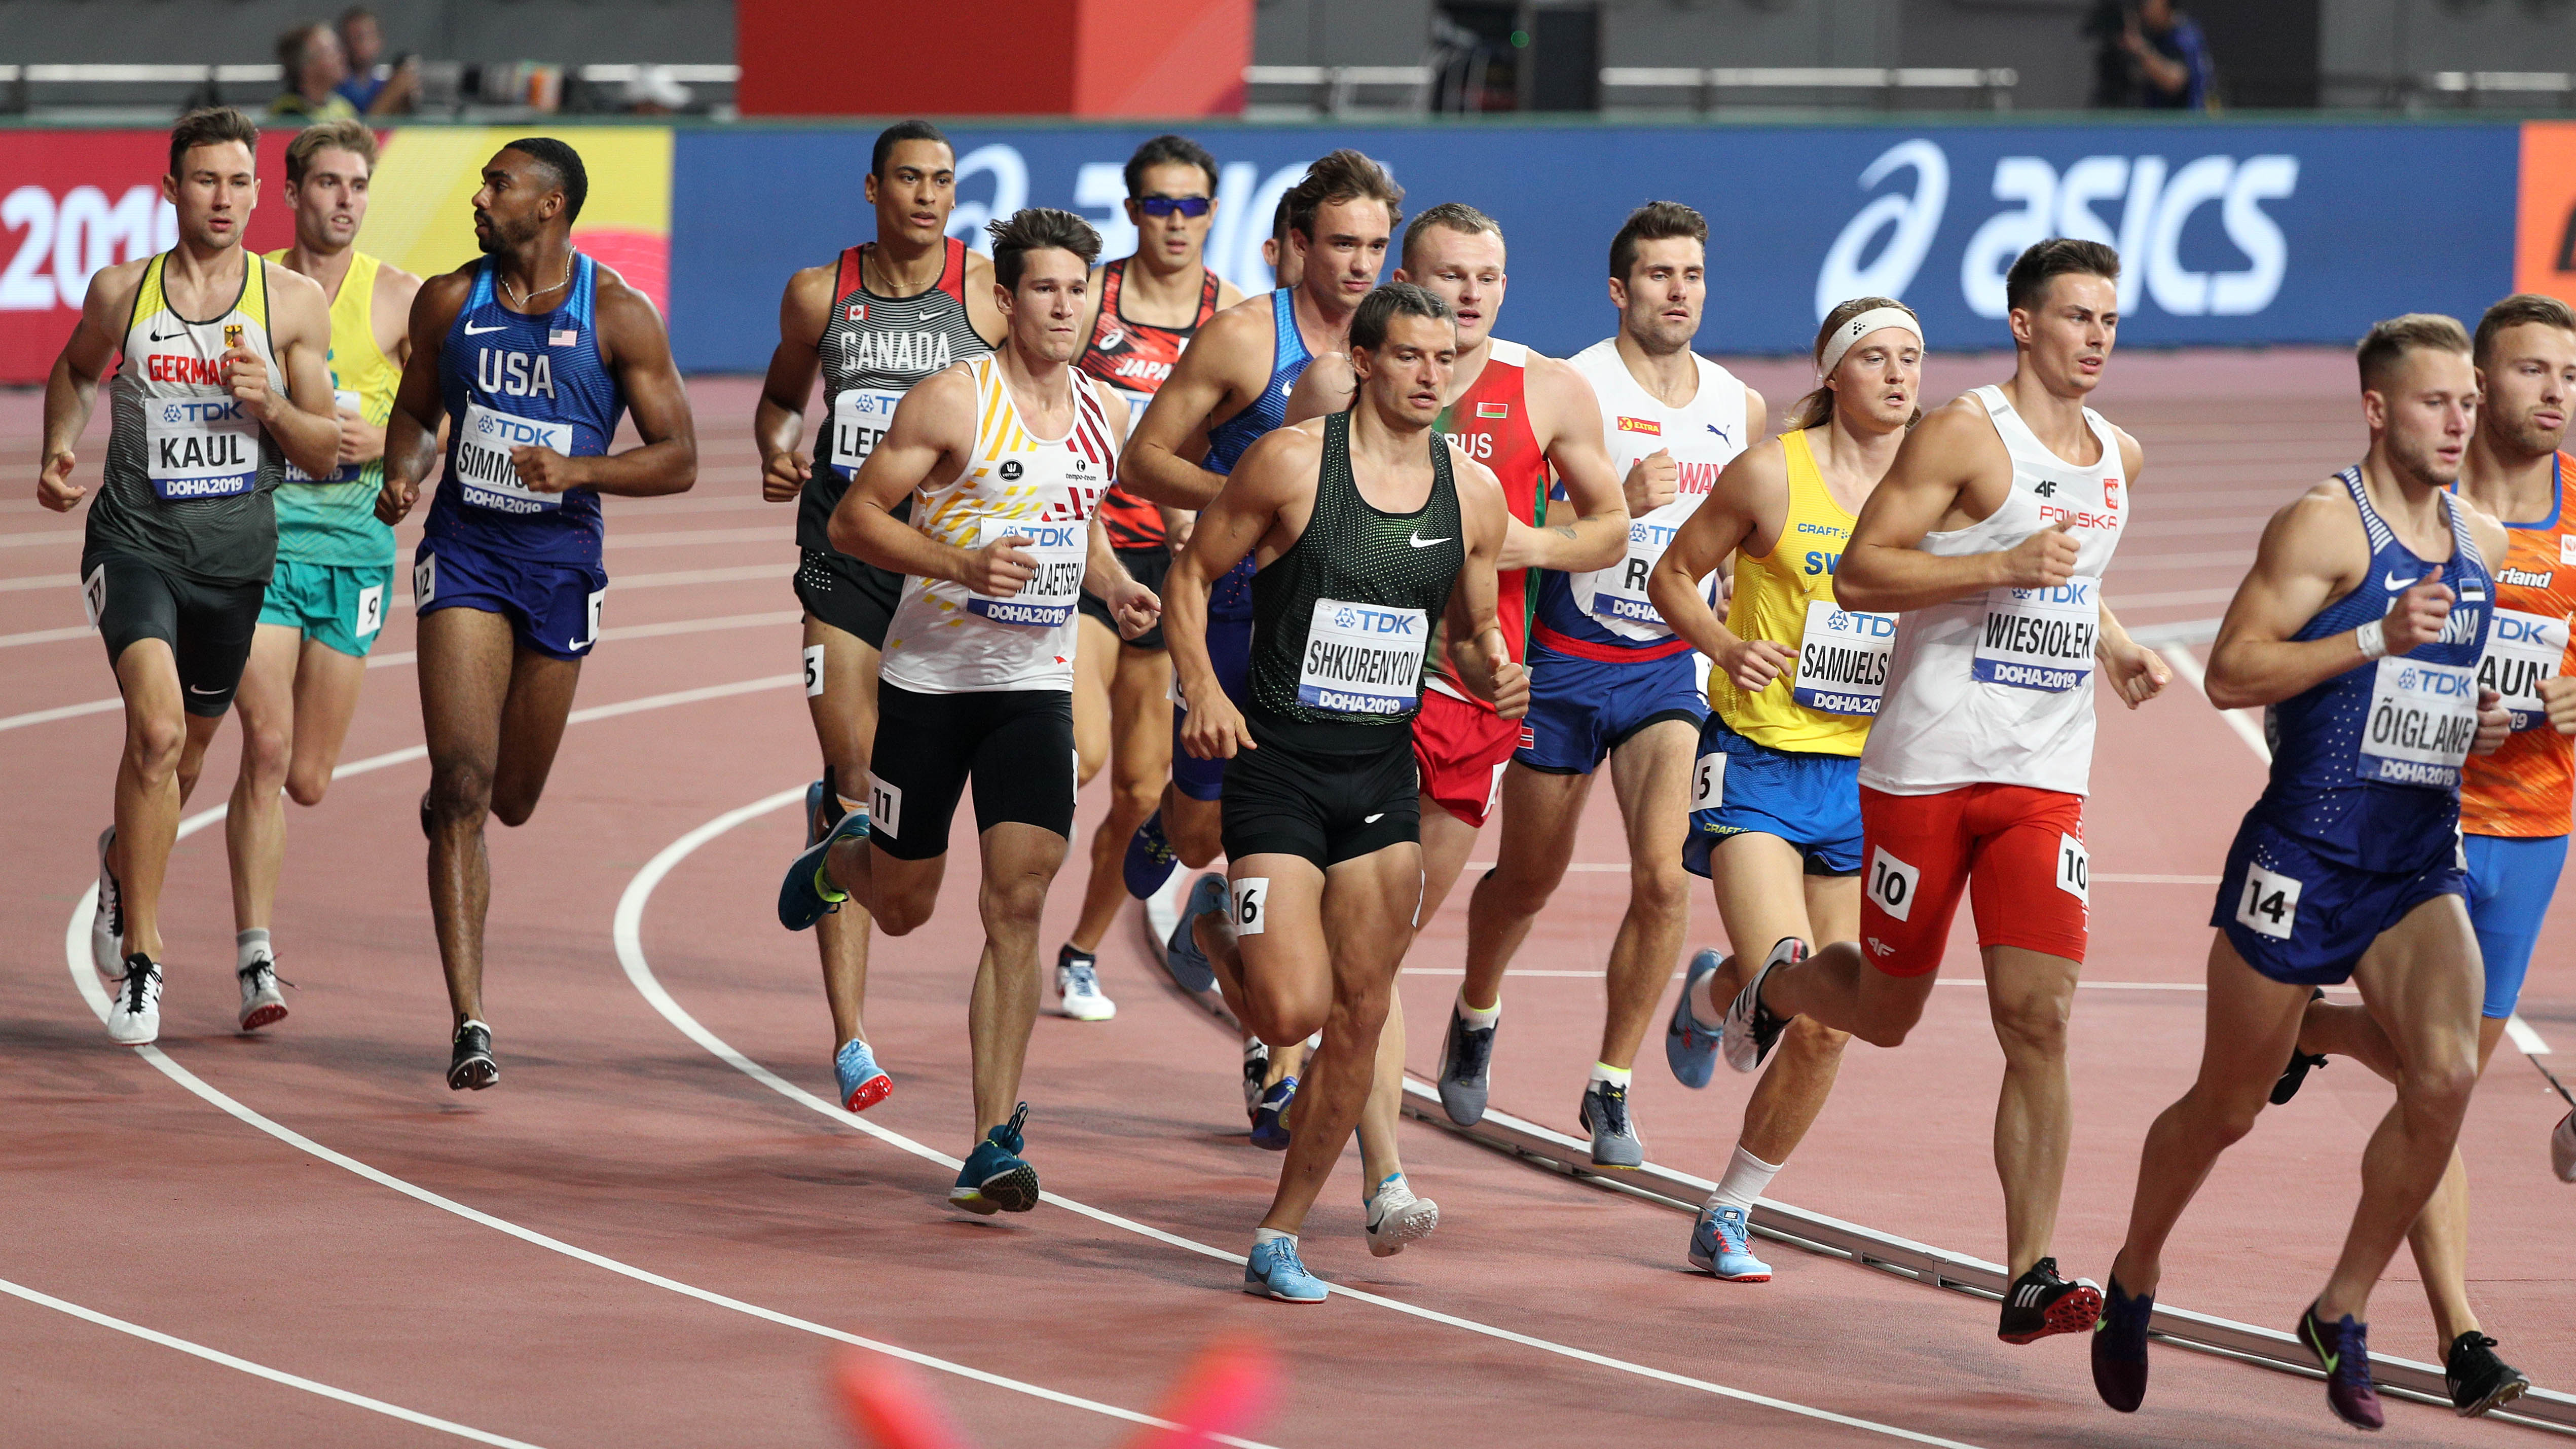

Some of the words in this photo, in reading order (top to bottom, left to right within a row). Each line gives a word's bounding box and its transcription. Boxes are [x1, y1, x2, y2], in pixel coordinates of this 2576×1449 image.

[840, 331, 951, 370] CANADA
[148, 354, 240, 386] GERMA
[478, 348, 555, 399] USA
[1115, 358, 1173, 381] JAPA
[181, 401, 243, 421] TDK
[495, 418, 556, 448] TDK
[1634, 421, 1660, 432] EXTRA
[160, 434, 245, 468] KAUL
[166, 476, 243, 496] DOHA2019
[2034, 480, 2057, 498] 4F
[1021, 527, 1075, 547] TDK
[1797, 523, 1839, 537] CRAFT
[2495, 567, 2553, 589] rland
[369, 597, 377, 624] 9
[986, 604, 1066, 624] DOHA2019
[1356, 609, 1416, 635] TDK
[1985, 612, 2094, 659] WIESIOŁEK
[1307, 640, 1420, 686] SHKURENYOV
[1802, 643, 1892, 686] SAMUELS
[1994, 663, 2077, 689] DOHA2019
[2419, 669, 2471, 698] TDK
[1318, 690, 1401, 715] DOHA2019
[2373, 697, 2473, 754] ÕIGLANE
[1699, 765, 1711, 800] 5
[2380, 760, 2456, 786] DOHA2019
[874, 787, 892, 825] 11
[1703, 823, 1742, 835] CRAFT
[1876, 861, 1907, 906] 10
[2065, 848, 2086, 890] 10
[1235, 888, 1258, 925] 16
[2249, 879, 2286, 924] 14
